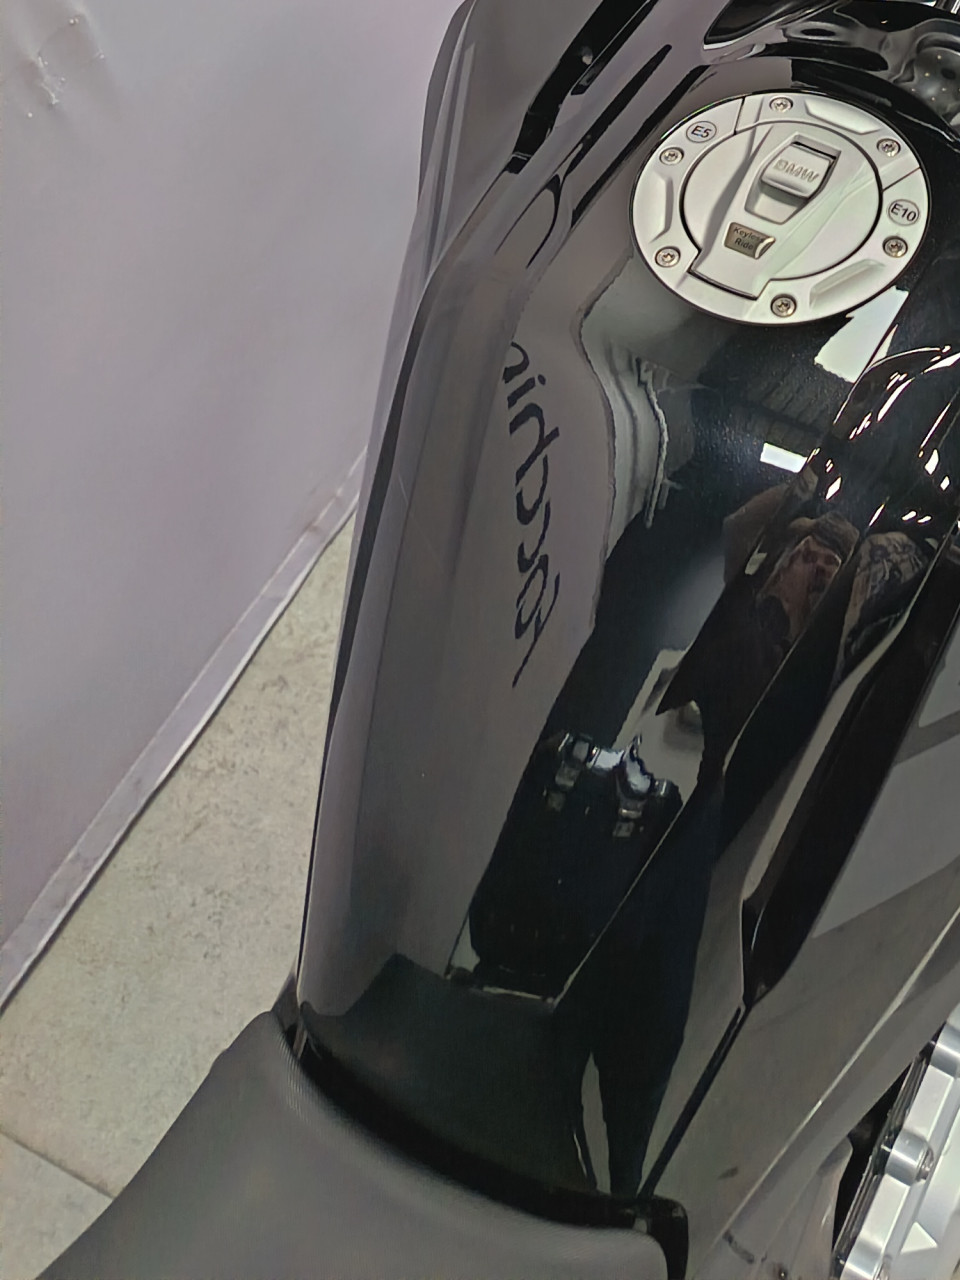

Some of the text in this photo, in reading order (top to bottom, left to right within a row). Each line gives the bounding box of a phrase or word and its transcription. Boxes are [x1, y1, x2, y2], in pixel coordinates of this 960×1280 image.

[690, 124, 712, 139] E5
[773, 159, 820, 183] BMW
[890, 202, 916, 223] E10
[734, 238, 755, 251] Ride
